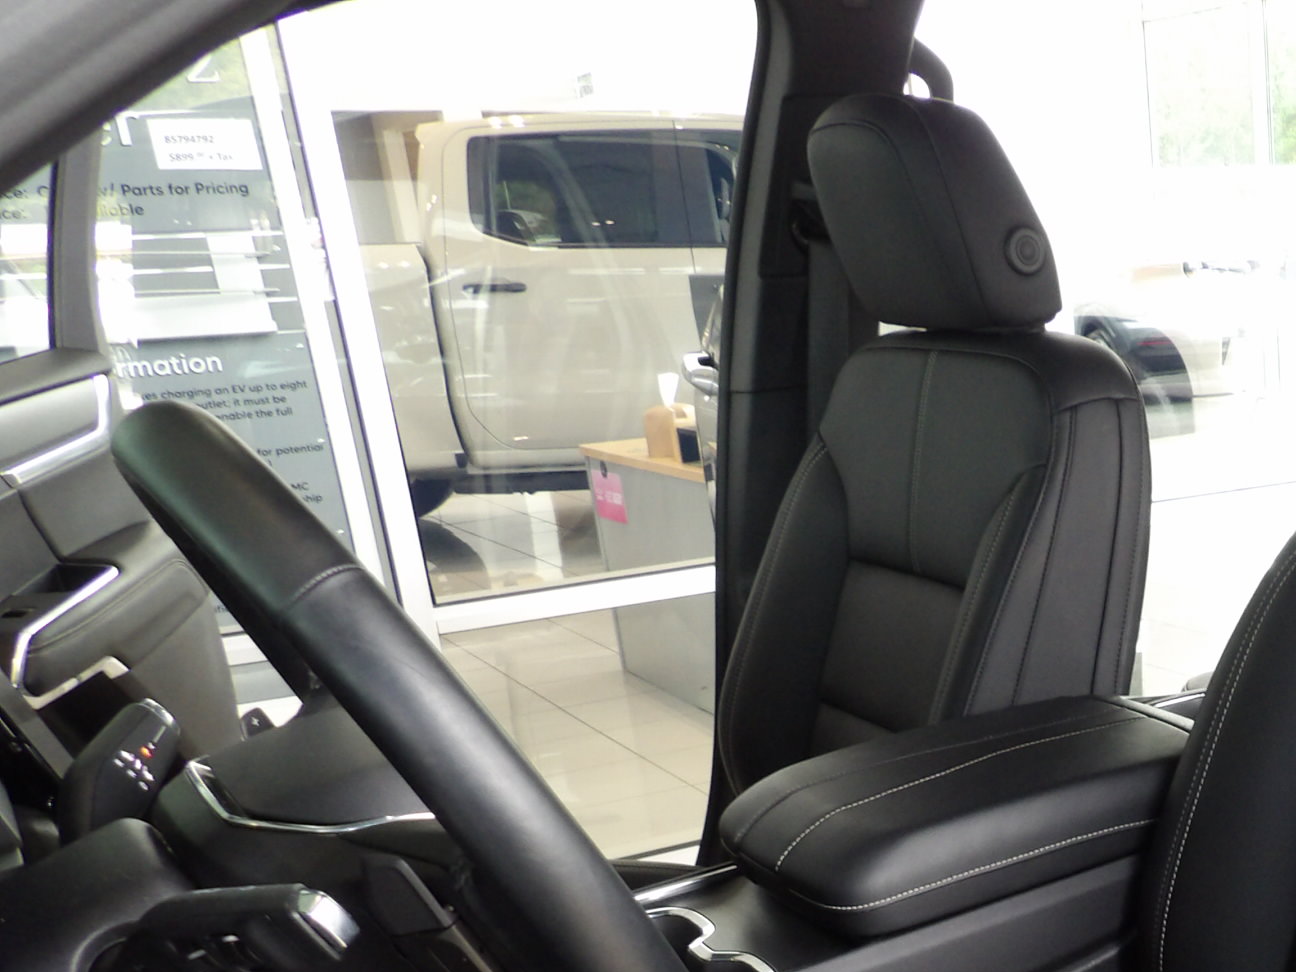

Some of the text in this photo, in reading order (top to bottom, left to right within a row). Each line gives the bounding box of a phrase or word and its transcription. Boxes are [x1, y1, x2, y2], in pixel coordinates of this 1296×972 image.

[121, 183, 164, 198] Parts
[168, 182, 191, 196] for
[195, 181, 249, 199] Pricing
[115, 352, 224, 378] rmation
[160, 387, 212, 401] charging
[214, 386, 230, 396] an
[231, 384, 246, 394] EV
[248, 384, 264, 395] up
[266, 382, 277, 391] to
[280, 379, 308, 393] eight
[243, 396, 270, 407] must
[272, 394, 287, 404] be
[255, 408, 274, 418] the
[275, 406, 293, 417] full
